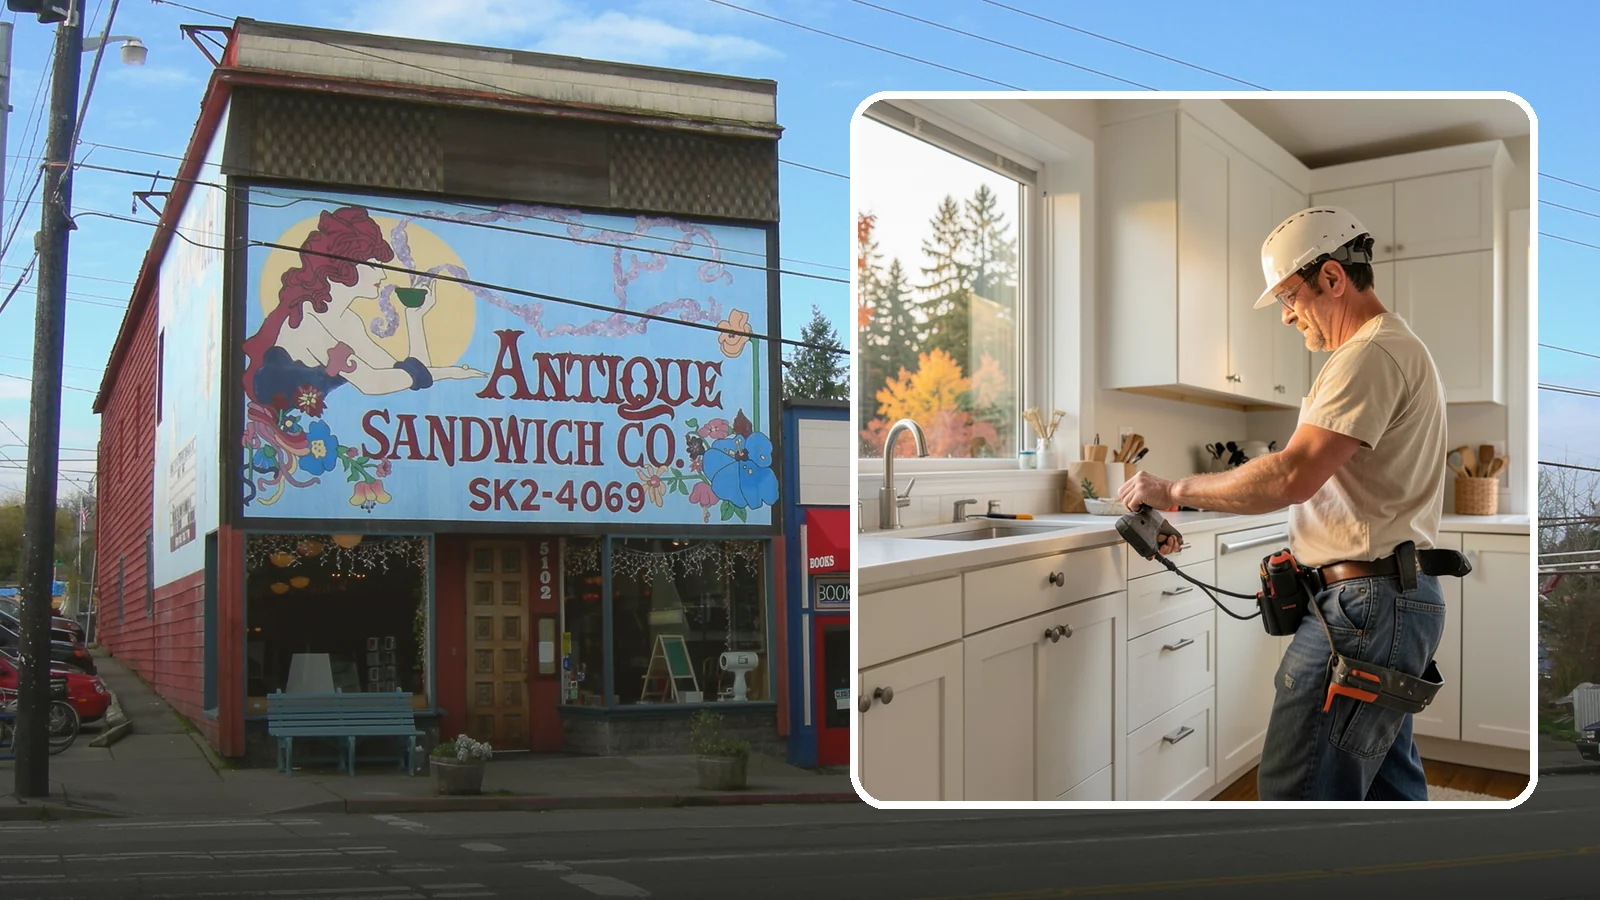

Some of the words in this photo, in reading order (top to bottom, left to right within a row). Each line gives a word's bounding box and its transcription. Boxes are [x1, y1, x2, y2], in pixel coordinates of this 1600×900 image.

[475, 329, 723, 421] ANTIQUE
[361, 408, 604, 467] SANDWICH
[617, 422, 684, 468] CO.
[468, 477, 645, 513] SK2-4069
[539, 541, 552, 599] 5102
[809, 555, 835, 569] BOOKS
